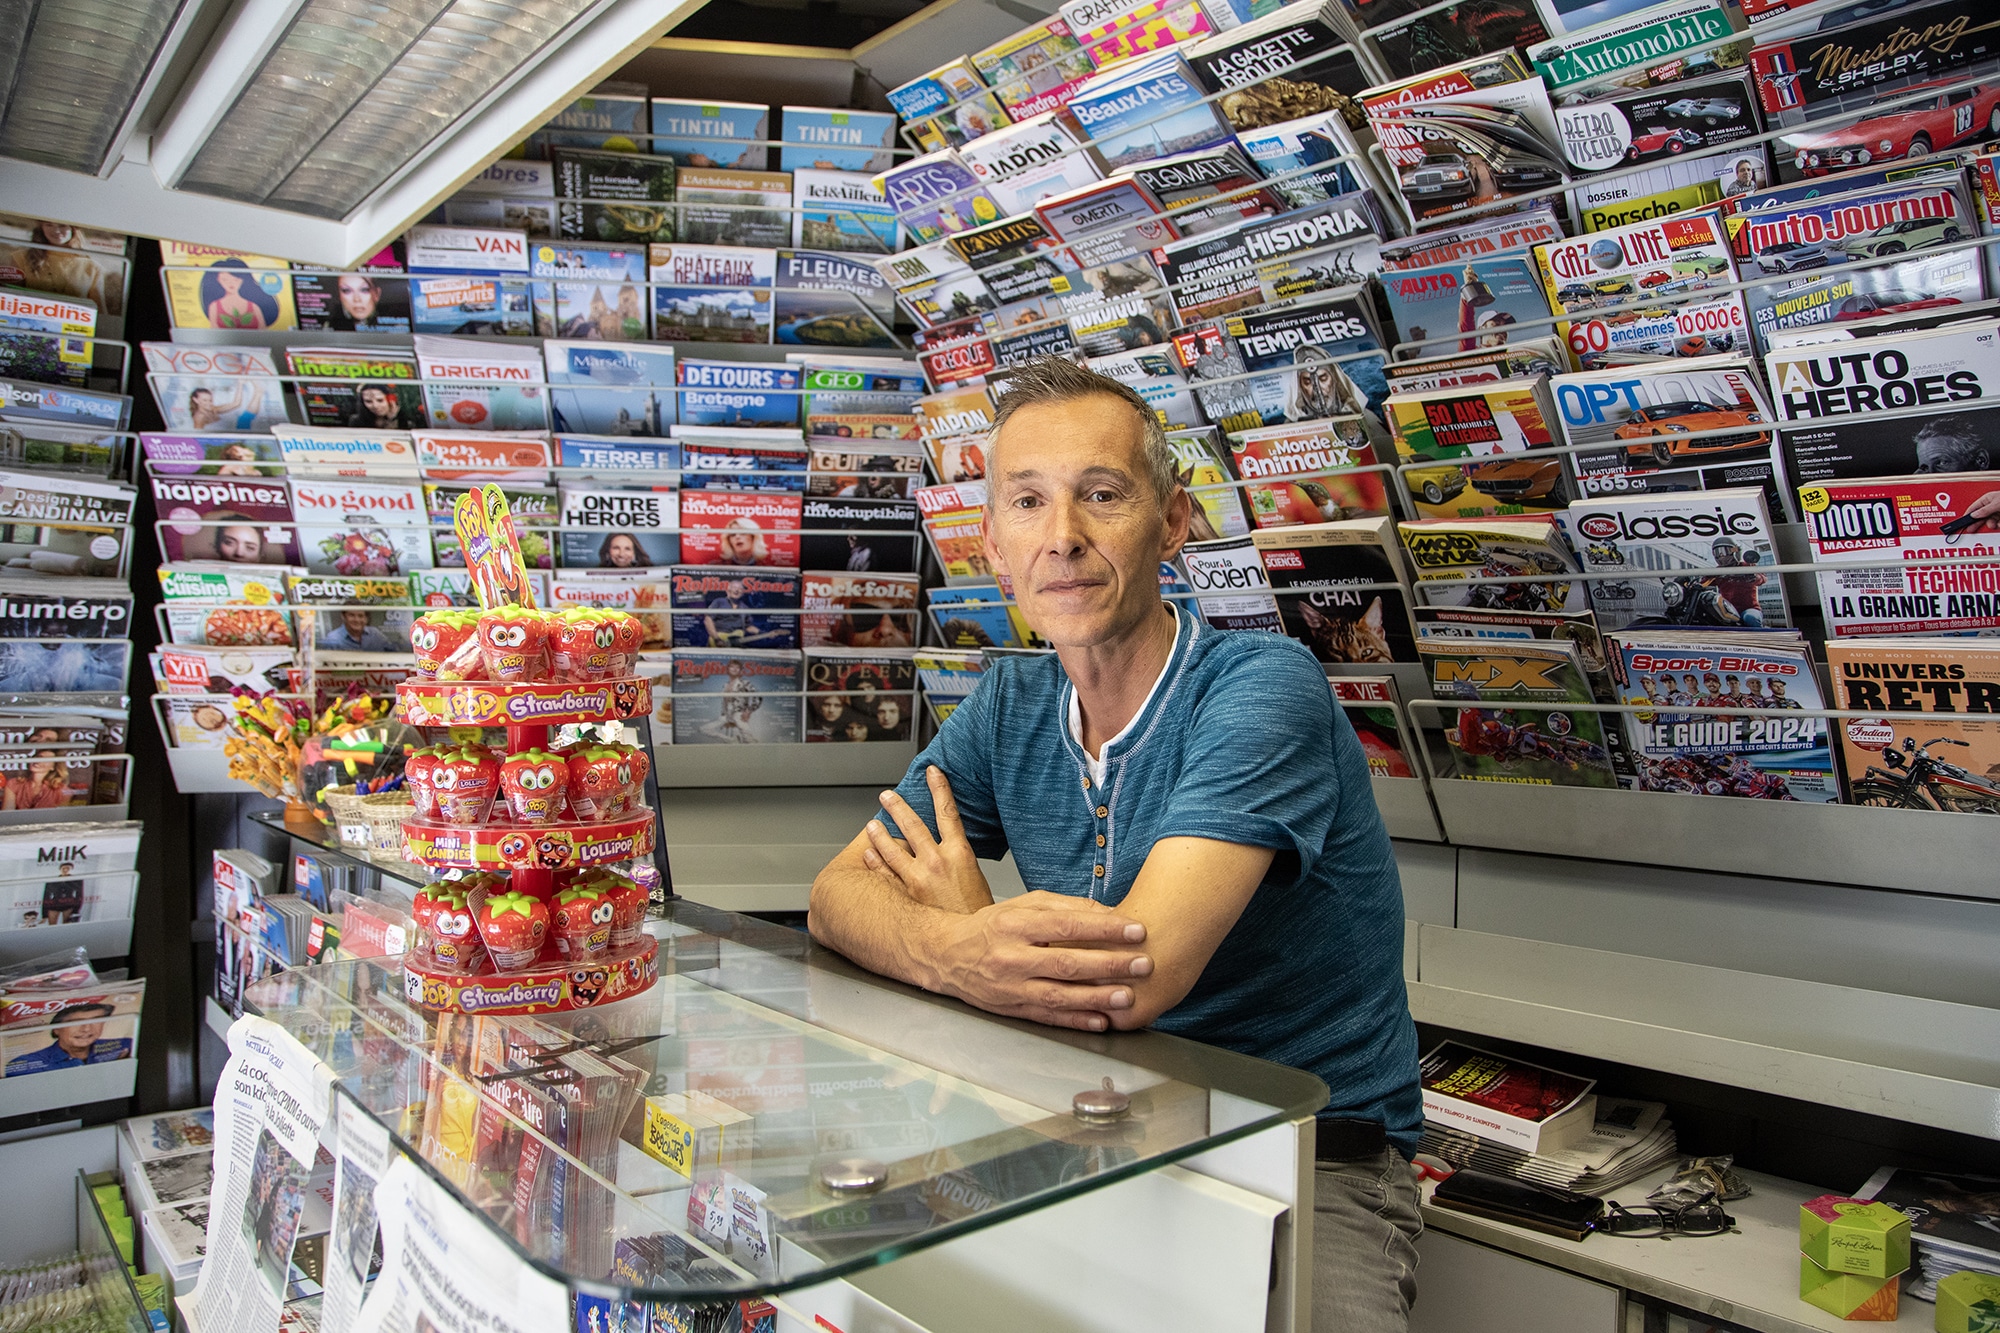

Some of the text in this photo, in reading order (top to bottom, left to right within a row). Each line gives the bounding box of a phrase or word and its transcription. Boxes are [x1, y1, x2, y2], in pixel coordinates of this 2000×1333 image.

[1613, 5, 1711, 35] HYBRIDES TESTÉES MESURÉES
[1750, 6, 1786, 23] Nouveau
[1207, 27, 1315, 77] LA GAZETTE
[1544, 15, 1722, 84] L'Automobile
[1809, 16, 1971, 81] Mustang
[1219, 51, 1297, 88] DROUOT
[1838, 51, 1924, 83] SHELBY
[903, 92, 945, 119] peindre
[1008, 94, 1058, 122] Peindre
[668, 117, 735, 138] TINTIN
[1563, 112, 1616, 137] RÉTRO
[798, 125, 863, 145] TINTIN
[1567, 137, 1627, 164] VISEUR
[682, 175, 755, 189] L'Archéologue
[1142, 160, 1241, 190] PLOMATIE
[889, 168, 957, 212] ARTS
[1587, 189, 1629, 203] DOSSIER
[1072, 202, 1126, 226] OMERTA
[1592, 199, 1681, 231] Porsche
[961, 219, 1042, 251] CONFLITS
[1245, 209, 1368, 258] HISTORIA
[1680, 223, 1693, 234] 14
[475, 237, 522, 254] VAN
[1091, 240, 1124, 259] VÉRITÉ
[1668, 231, 1714, 248] HORS-SÉRIE
[674, 250, 754, 273] CHÂTEAUX
[1099, 246, 1138, 265] TERRAIN
[1179, 257, 1209, 274] GUILLAUME
[788, 259, 884, 288] FLEUVES
[892, 256, 931, 280] GBM
[1196, 285, 1227, 303] CONQUÊTE
[1401, 273, 1458, 296] AUTO
[428, 289, 496, 308] NOUVEAUTÉS
[1402, 286, 1458, 304] hebdo
[1755, 281, 1853, 323] CES NOUVEAUX SUV
[11, 297, 93, 323] jardins
[1702, 303, 1721, 311] moins
[1778, 302, 1832, 331] CASSENT
[1250, 310, 1344, 335] Les derniers secrets des
[1238, 317, 1367, 358] TEMPLIERS
[1568, 320, 1609, 356] 60
[1611, 322, 1675, 343] anciennes
[1977, 334, 1993, 342] 037
[154, 349, 273, 377] YOGA
[573, 353, 648, 370] Marseille
[1775, 350, 1909, 393] AUTO
[430, 365, 529, 379] ORIGAMI
[686, 365, 774, 387] DÉTOURS
[815, 371, 863, 389] GEO
[60, 394, 116, 415] Travaux
[685, 391, 766, 408] Bretagne
[1557, 374, 1740, 426] OPTION
[1782, 371, 1983, 421] HEROES
[1425, 399, 1491, 427] 50 ANS
[1433, 419, 1495, 433] D'AUTOMOBILES
[283, 438, 384, 454] philosophie
[1274, 435, 1331, 453] Monde
[1435, 426, 1500, 447] ITALIENNES
[150, 440, 196, 457] simple
[421, 438, 481, 458] Open
[579, 448, 655, 465] TERRE
[1597, 454, 1617, 462] MARTIN
[683, 452, 755, 470] jazz
[1242, 448, 1353, 478] Animaux
[1797, 457, 1824, 465] Collection
[1588, 466, 1627, 477] MATURITÉ
[1724, 466, 1771, 479] DOSSIER
[153, 479, 287, 505] happinez
[1586, 474, 1647, 493] 665 CH
[14, 490, 103, 509] Design à la
[297, 488, 416, 512] So good
[1802, 491, 1822, 502] 132
[1805, 497, 1825, 508] PAGES
[566, 510, 660, 527] HEROES
[1577, 507, 1760, 542] Classic
[1819, 502, 1893, 537] MOTO
[1899, 507, 1912, 525] 5
[1412, 533, 1475, 552] Moto
[1823, 536, 1896, 550] MAGAZINE
[1265, 556, 1303, 568] SCIENCES
[1417, 549, 1486, 565] revue
[161, 579, 229, 598] Cuisine
[554, 586, 669, 602] Cuisine Vins
[741, 577, 795, 593] Stone
[1830, 595, 1942, 618] LA GRANDE
[1468, 614, 1494, 622] MANIFS
[1870, 624, 1892, 634] vigueur
[1906, 622, 1920, 631] avril
[1923, 621, 1938, 629] Tous
[1938, 620, 1949, 629] les
[1949, 619, 1971, 628] détails
[1972, 618, 1980, 626] de
[743, 661, 796, 677] Stone
[809, 663, 913, 682] QUEEN
[1631, 653, 1800, 676] Sport Bikes
[1843, 662, 1966, 680] UNIVERS
[509, 689, 607, 719] Strawberry
[1645, 717, 1817, 748] LE GUIDE 2024
[1849, 725, 1892, 738] Indian
[1755, 742, 1814, 751] CIRCUITS DÉCRYPTÉS
[37, 845, 88, 862] MilK
[460, 984, 561, 1009] Strawberry
[1431, 1056, 1483, 1090] RÈGLEMENTS
[1456, 1058, 1495, 1088] COMPTES
[1465, 1061, 1508, 1093] MARSEILLE
[234, 1079, 251, 1096] son
[277, 1090, 300, 1118] CPMM
[655, 1111, 681, 1135] L'agenda
[1477, 1117, 1501, 1130] RÈGLEMENTS
